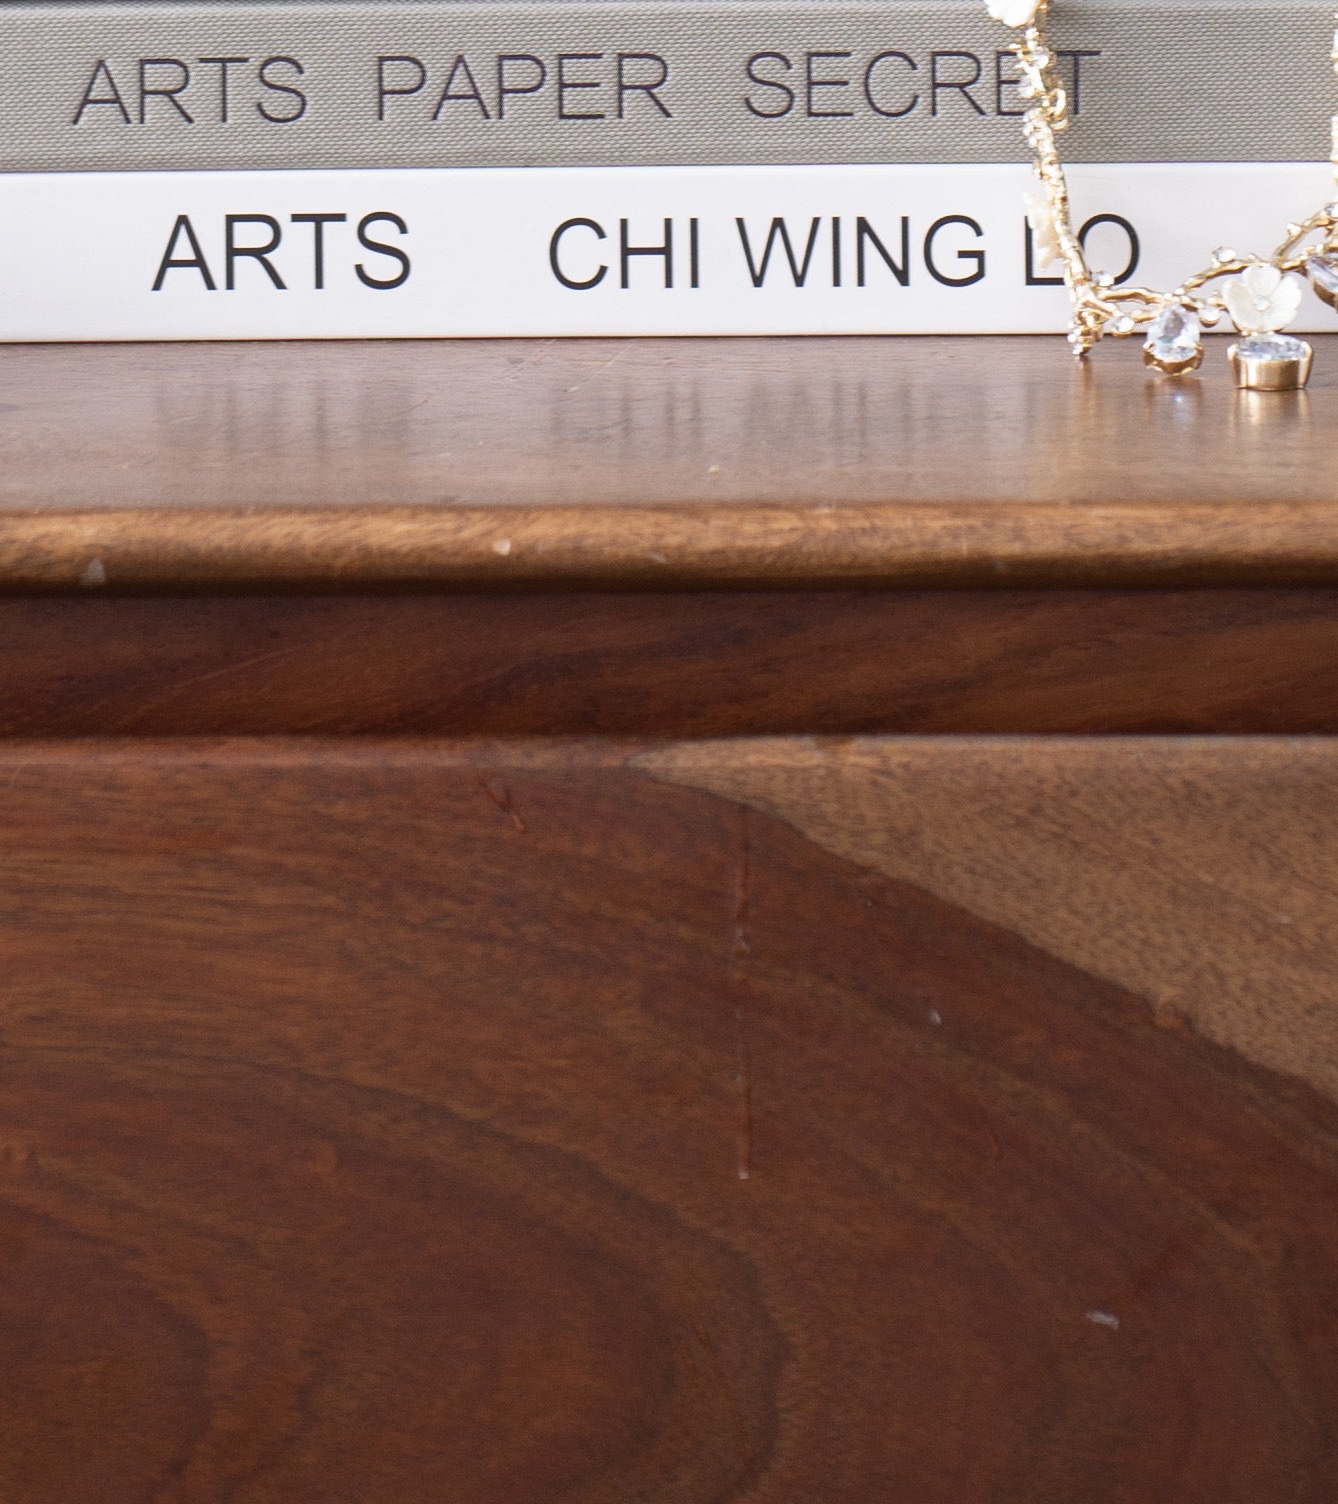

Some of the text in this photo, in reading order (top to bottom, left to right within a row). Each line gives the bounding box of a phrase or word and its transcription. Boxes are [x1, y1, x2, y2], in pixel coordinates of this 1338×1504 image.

[71, 49, 1102, 125] ARTS PAPER SECRET
[151, 211, 1141, 291] ARTS CHI WING LO
